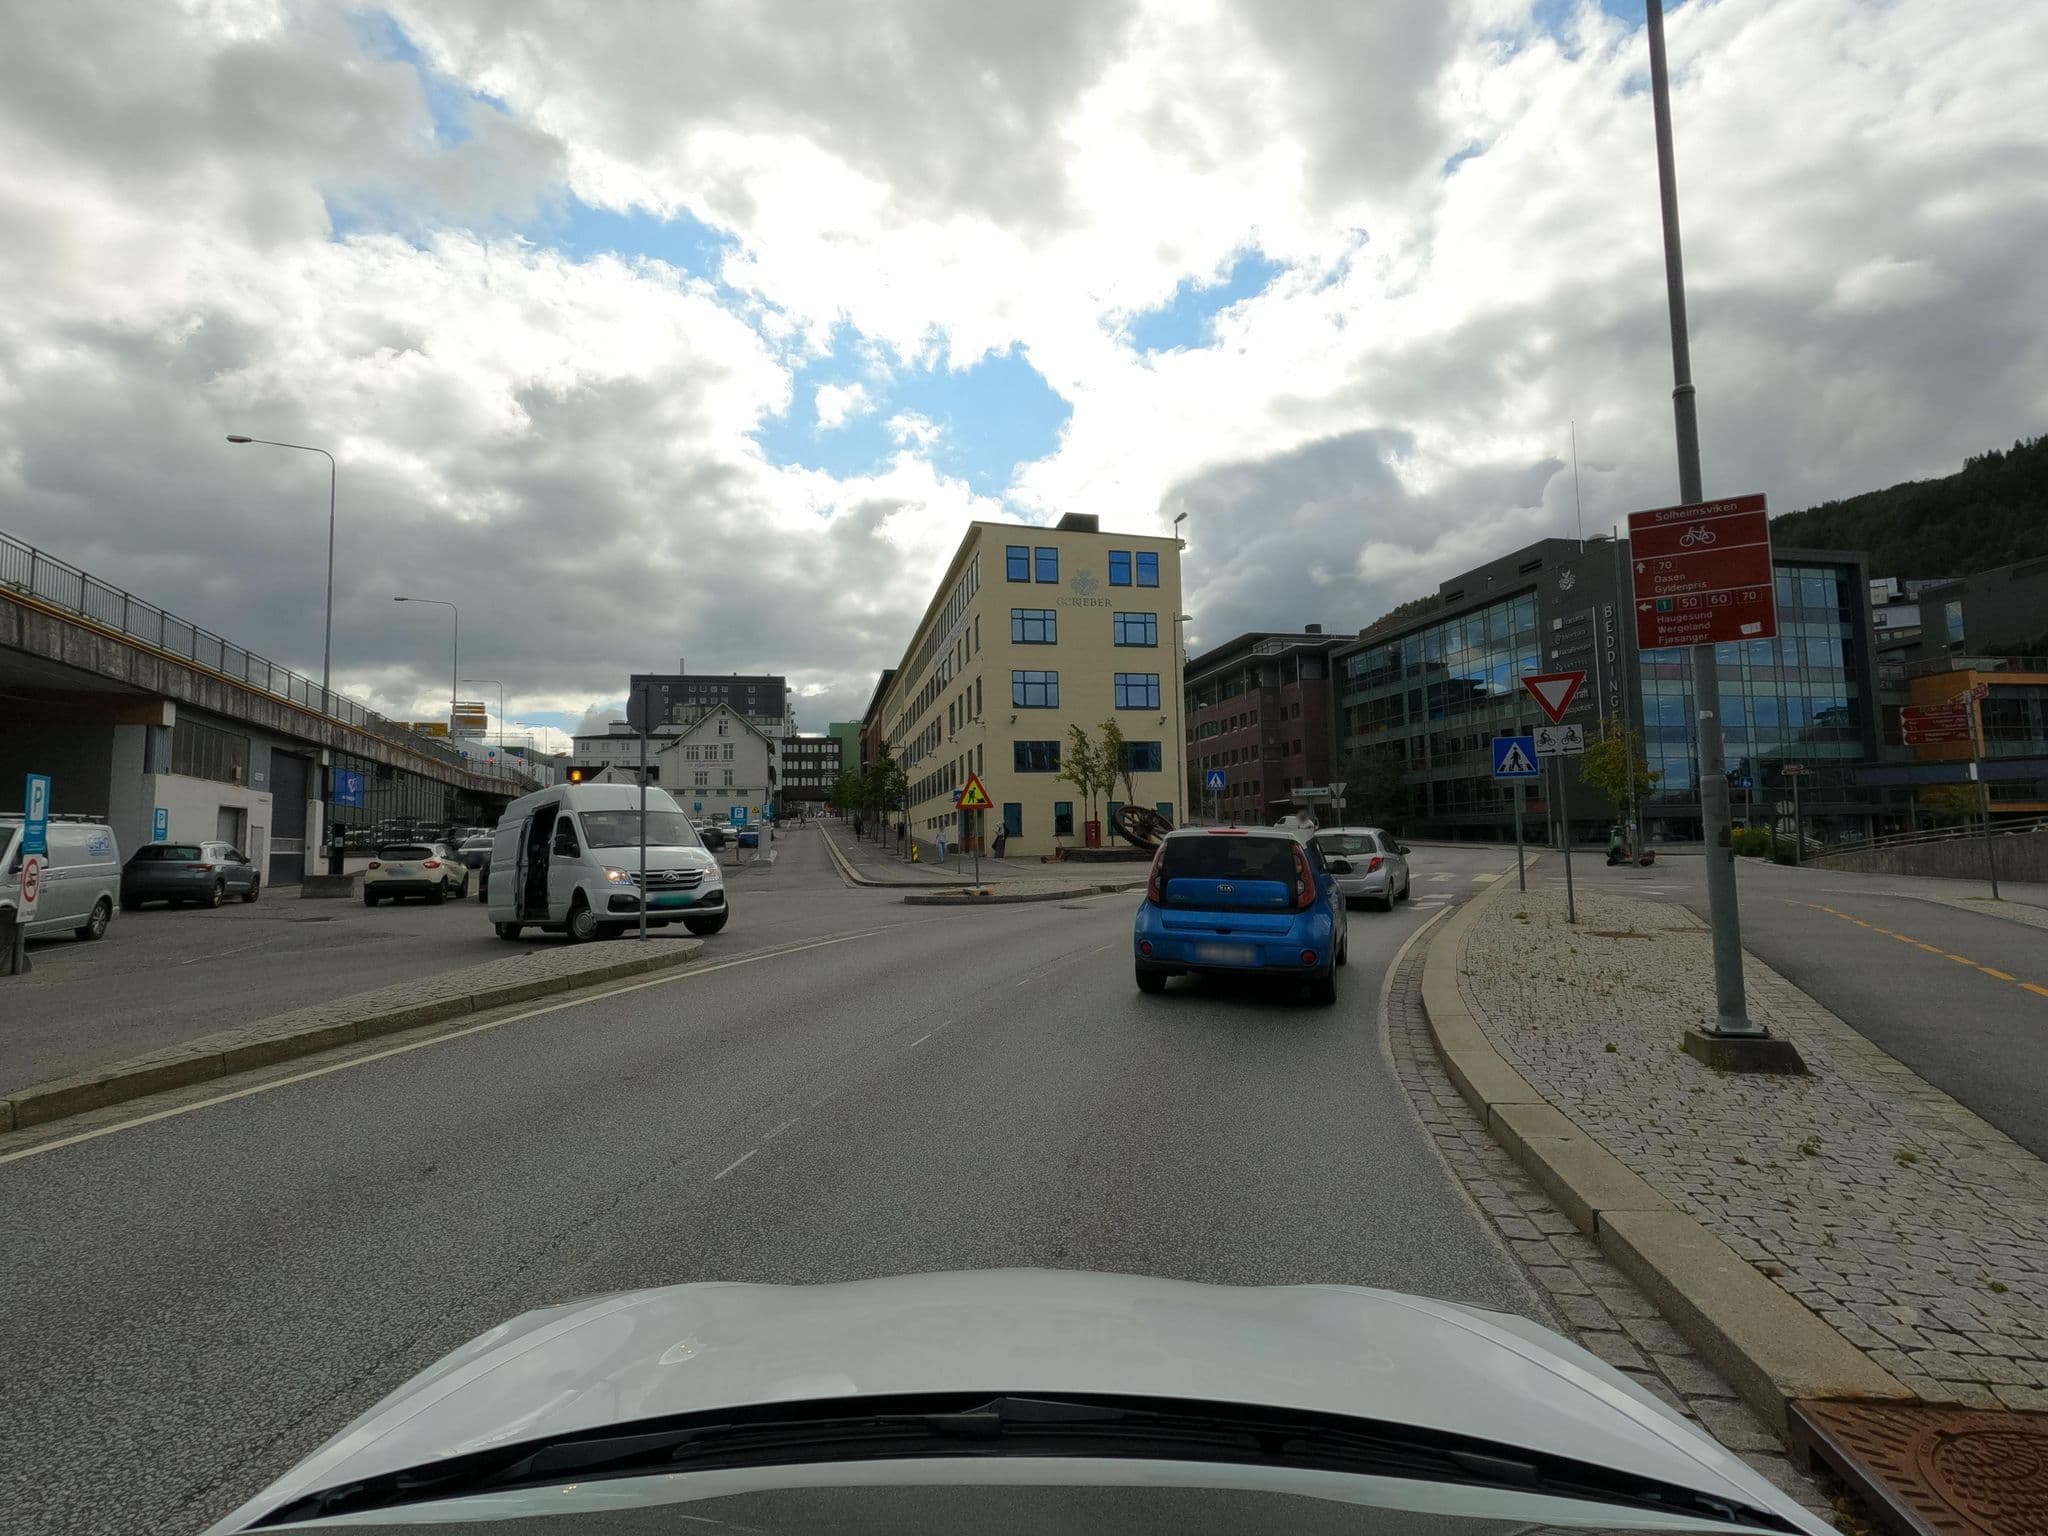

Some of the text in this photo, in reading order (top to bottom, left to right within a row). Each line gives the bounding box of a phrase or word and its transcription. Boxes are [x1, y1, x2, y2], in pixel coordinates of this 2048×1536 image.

[1655, 503, 1738, 521] Solheimsviken
[1659, 561, 1673, 570] 70
[1654, 574, 1686, 583] Oasen
[1654, 581, 1708, 594] Gyldenpris
[1681, 597, 1698, 608] 50
[1711, 594, 1727, 604] 60
[1742, 591, 1757, 601] 70
[1657, 611, 1713, 623] Haugesund
[1658, 622, 1711, 634] Wergeland
[1659, 633, 1709, 645] Fjøsanger
